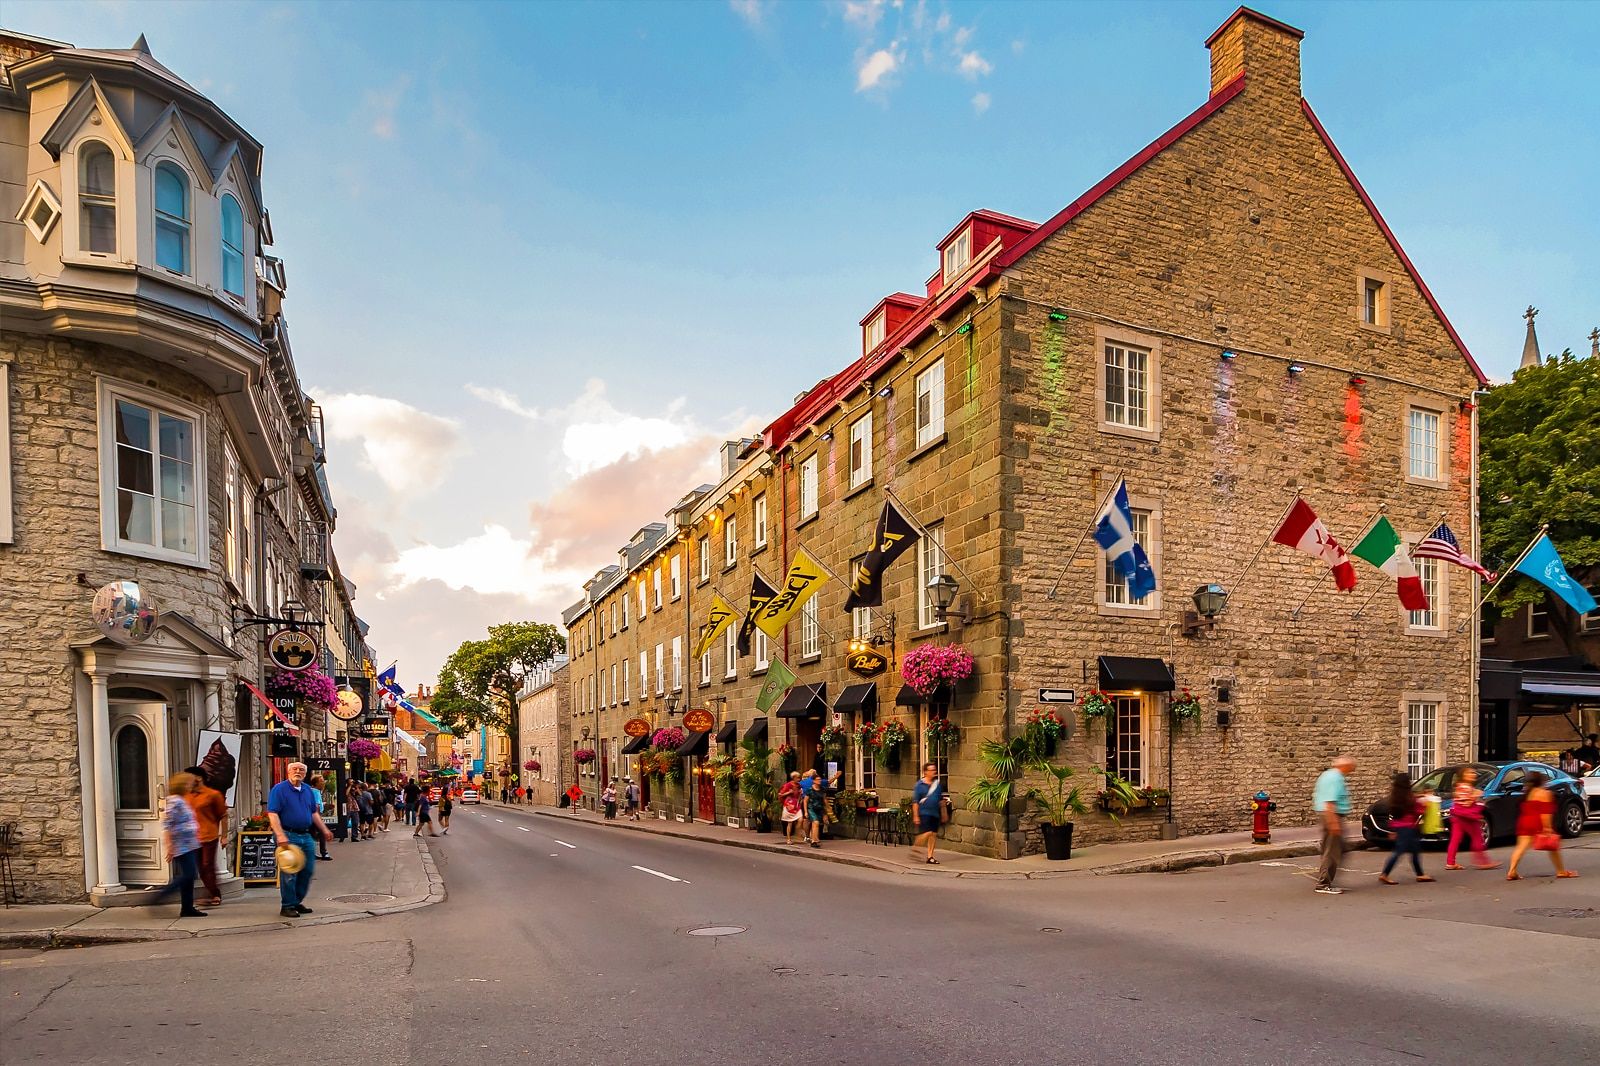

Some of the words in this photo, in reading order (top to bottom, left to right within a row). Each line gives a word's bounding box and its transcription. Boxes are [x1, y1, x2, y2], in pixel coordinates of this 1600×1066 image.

[853, 655, 882, 670] Bello
[276, 698, 294, 708] LON
[318, 760, 330, 769] 72
